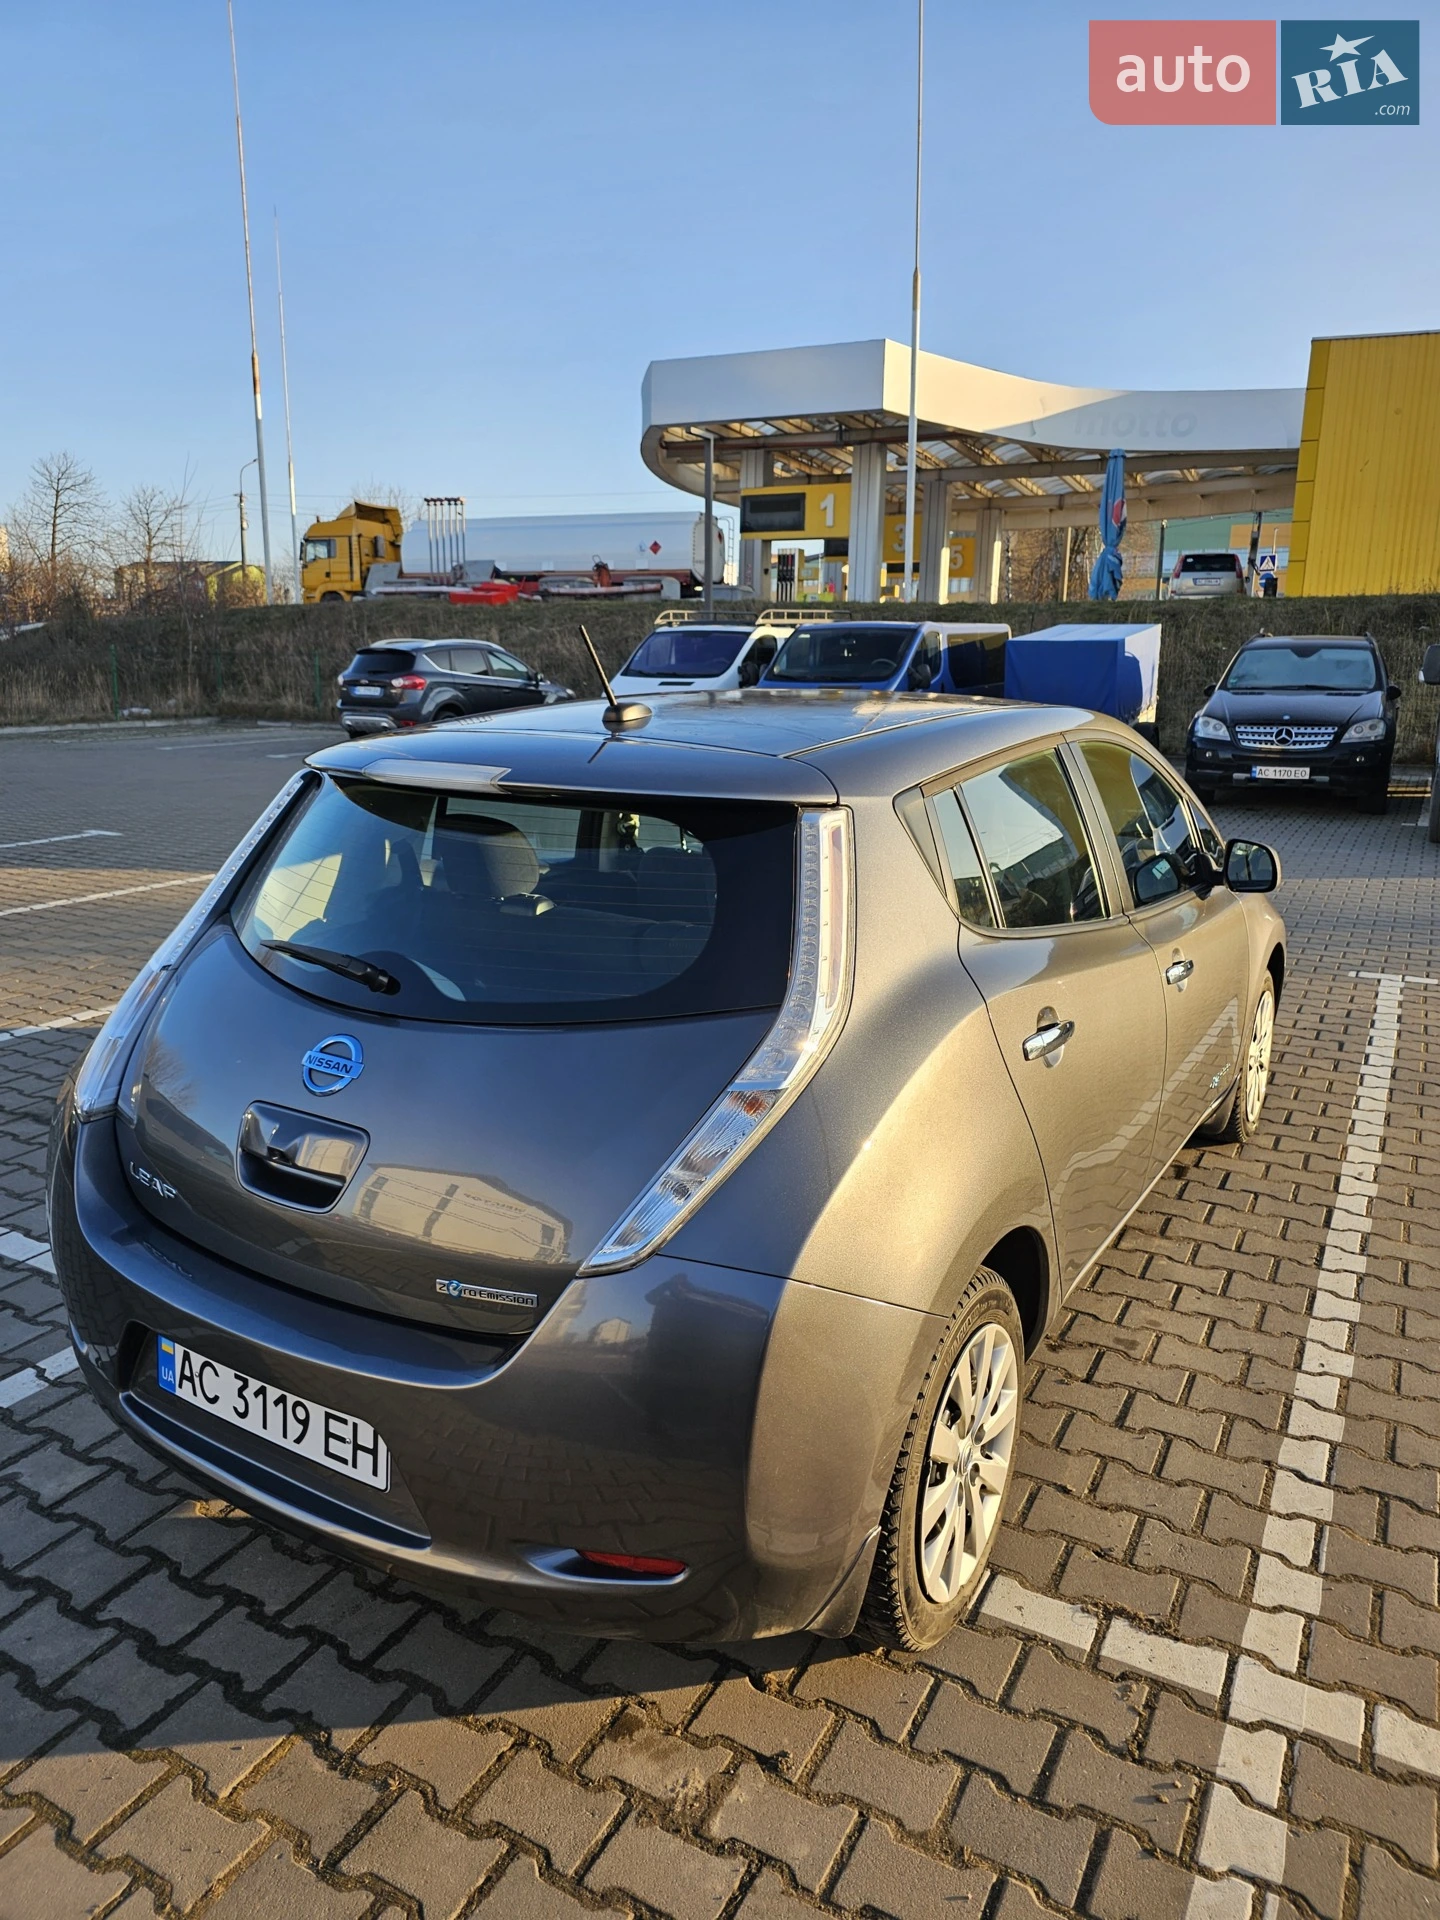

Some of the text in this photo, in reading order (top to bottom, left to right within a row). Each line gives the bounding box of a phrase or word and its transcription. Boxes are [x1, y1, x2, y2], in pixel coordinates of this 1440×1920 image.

[820, 493, 835, 528] 1
[892, 523, 905, 553] 3
[950, 545, 963, 570] 5
[1257, 768, 1307, 778] AC 1170 EO
[306, 1054, 353, 1074] NISSAN
[130, 1161, 176, 1199] LEAF
[161, 1366, 174, 1383] UA
[178, 1349, 379, 1478] AC 3119 EH
